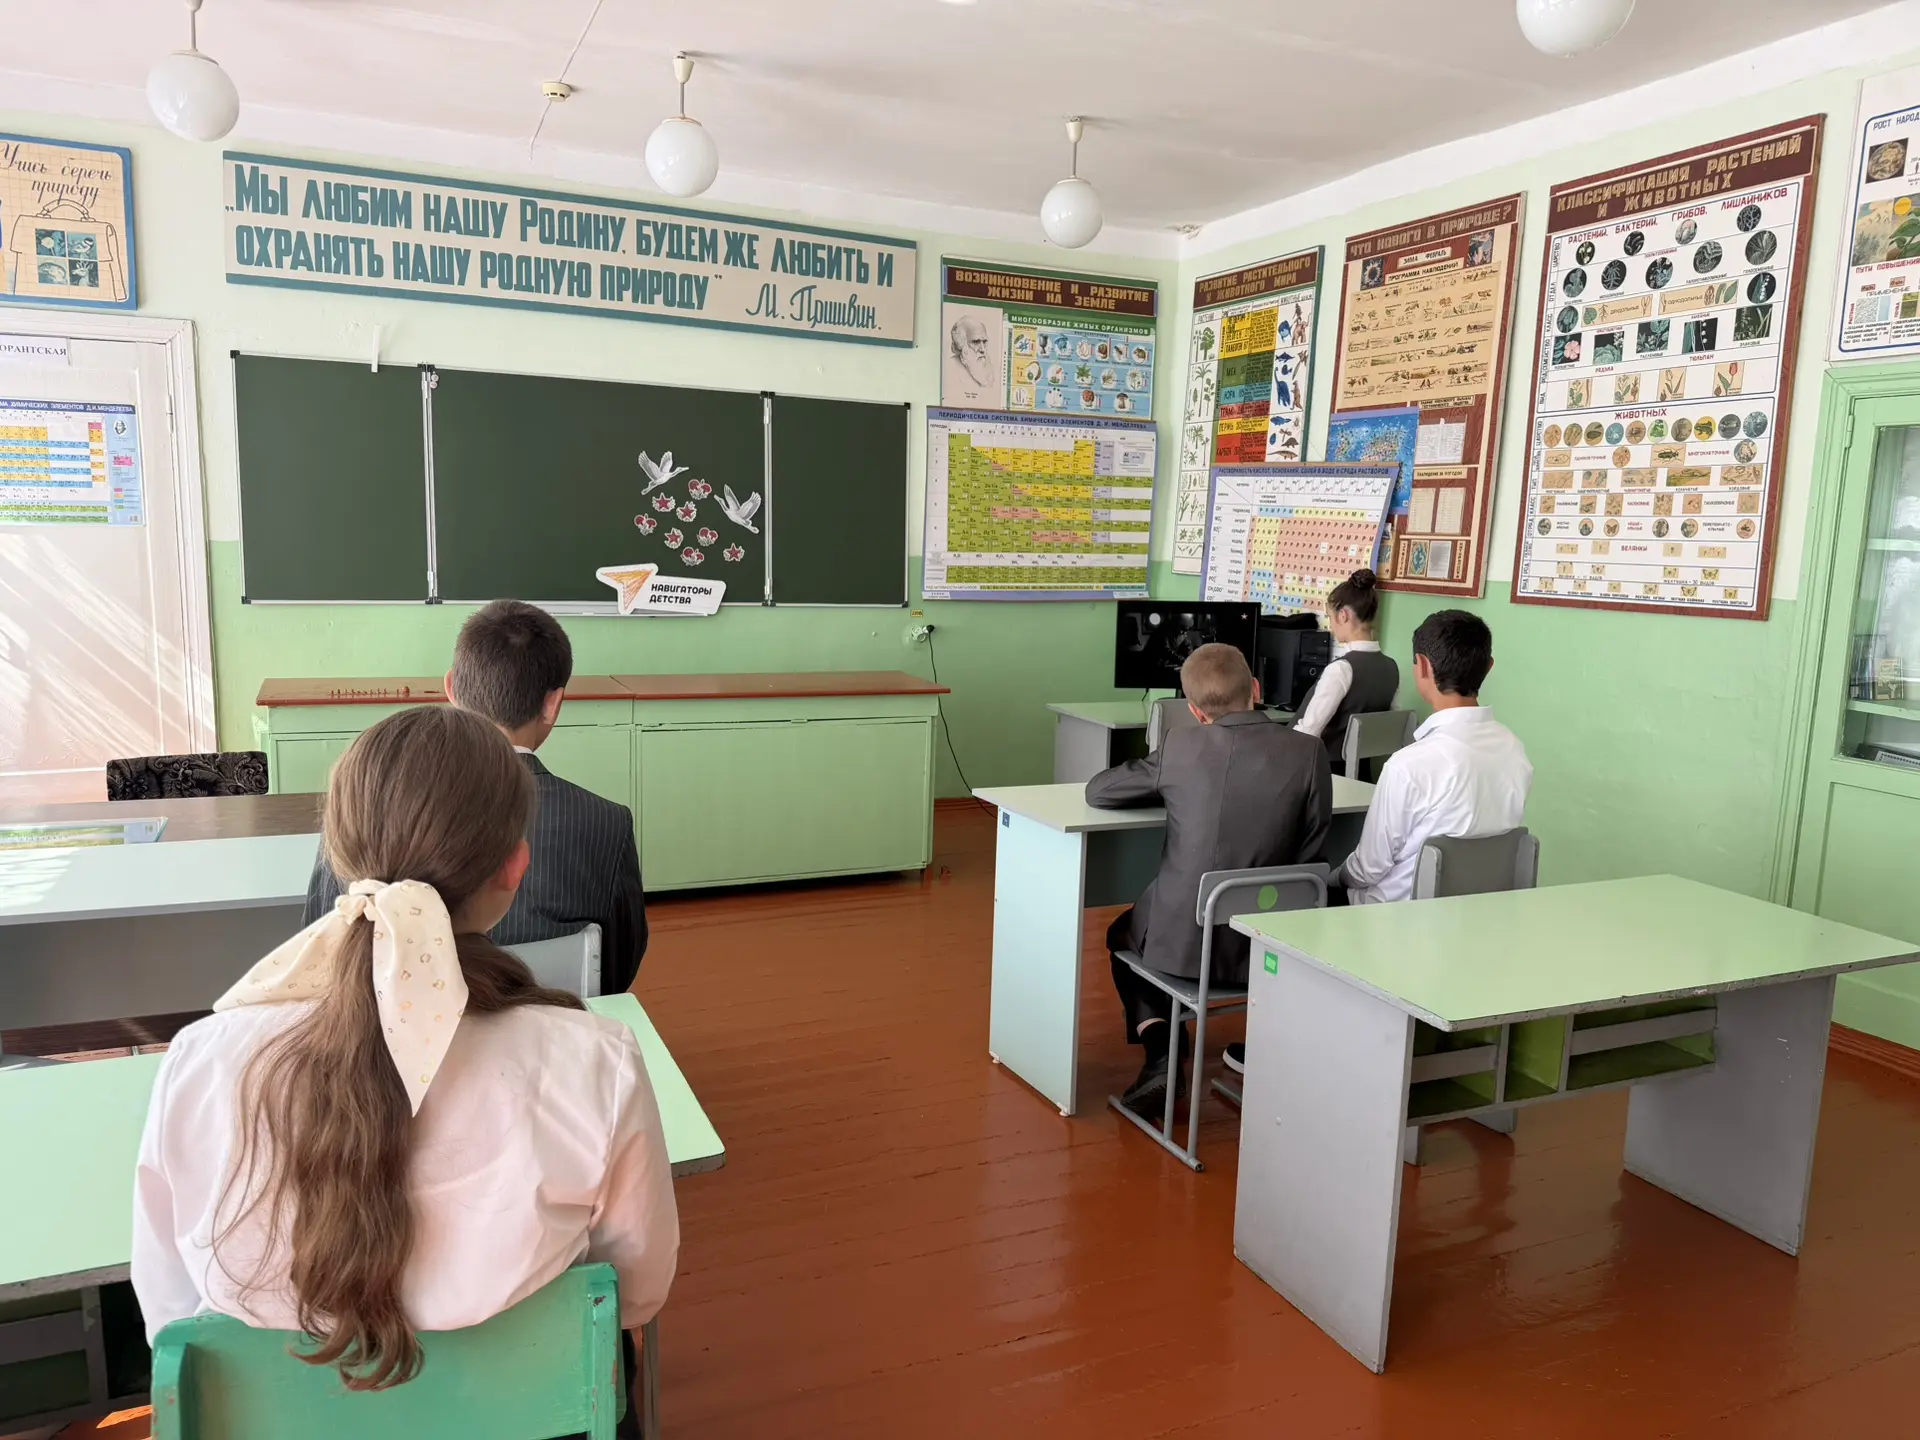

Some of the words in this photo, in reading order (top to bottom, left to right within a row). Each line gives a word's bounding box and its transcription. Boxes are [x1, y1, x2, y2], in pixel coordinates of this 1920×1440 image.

[1873, 119, 1892, 130] РОСТ
[60, 157, 112, 185] беречь
[1556, 164, 1690, 213] КЛАССИФИКАЦИЯ
[1706, 133, 1802, 177] РАСТЕНИЙ
[31, 179, 100, 208] природу
[1597, 202, 1608, 219] И
[1624, 172, 1734, 213] ЖИВОТНЫХ
[301, 179, 412, 230] ЛЮБИМ
[422, 192, 508, 239] НАШУ
[635, 217, 718, 265] БУДЕМ
[723, 230, 760, 270] ЖЕ
[770, 237, 870, 285] ЛЮБИТЬ
[877, 252, 894, 288] И
[1350, 241, 1372, 258] ЧТО
[1376, 228, 1421, 250] НОВОГО
[1427, 224, 1436, 239] В
[1440, 204, 1512, 235] ПРИРОДЕ?
[235, 225, 384, 278] ОХРАНЯТЬ
[392, 240, 471, 287] НАШУ
[479, 250, 592, 298] РОДНУЮ
[1199, 274, 1238, 293] РАЗВИТИЕ
[1242, 255, 1311, 284] РАСТИТЕЛЬНОГО
[1388, 269, 1420, 282] ПРОГРАММА
[1855, 266, 1873, 274] ПУТИ
[955, 270, 1061, 293] ВОЗНИКНОВЕНИЕ
[1071, 283, 1079, 294] И
[1090, 285, 1149, 303] РАЗВИТИЕ
[987, 286, 1034, 301] ЖИЗНИ
[1046, 293, 1062, 305] НА
[1074, 296, 1116, 310] ЗЕМЛЕ
[1216, 278, 1266, 301] ЖИВОТНОГО
[1273, 272, 1297, 289] МИРА
[745, 282, 786, 320] М.
[790, 284, 882, 332] Пришвин.
[1011, 315, 1071, 328] МНОГООБРАЗИЕ
[1073, 322, 1099, 331] ЖИВЫХ
[1101, 325, 1149, 335] ОРГАНИЗМОВ
[938, 412, 989, 420] ПЕРИОДИЧЕСКАЯ
[1020, 416, 1058, 424] ХИМИЧЕСКИХ
[1060, 418, 1094, 427] ЭЛЕМЕНТОВ
[1614, 408, 1667, 420] ЖИВОТНЫХ
[649, 594, 692, 605] ДЕТСТВА
[651, 584, 712, 596] НАВИГАТОРЫ
